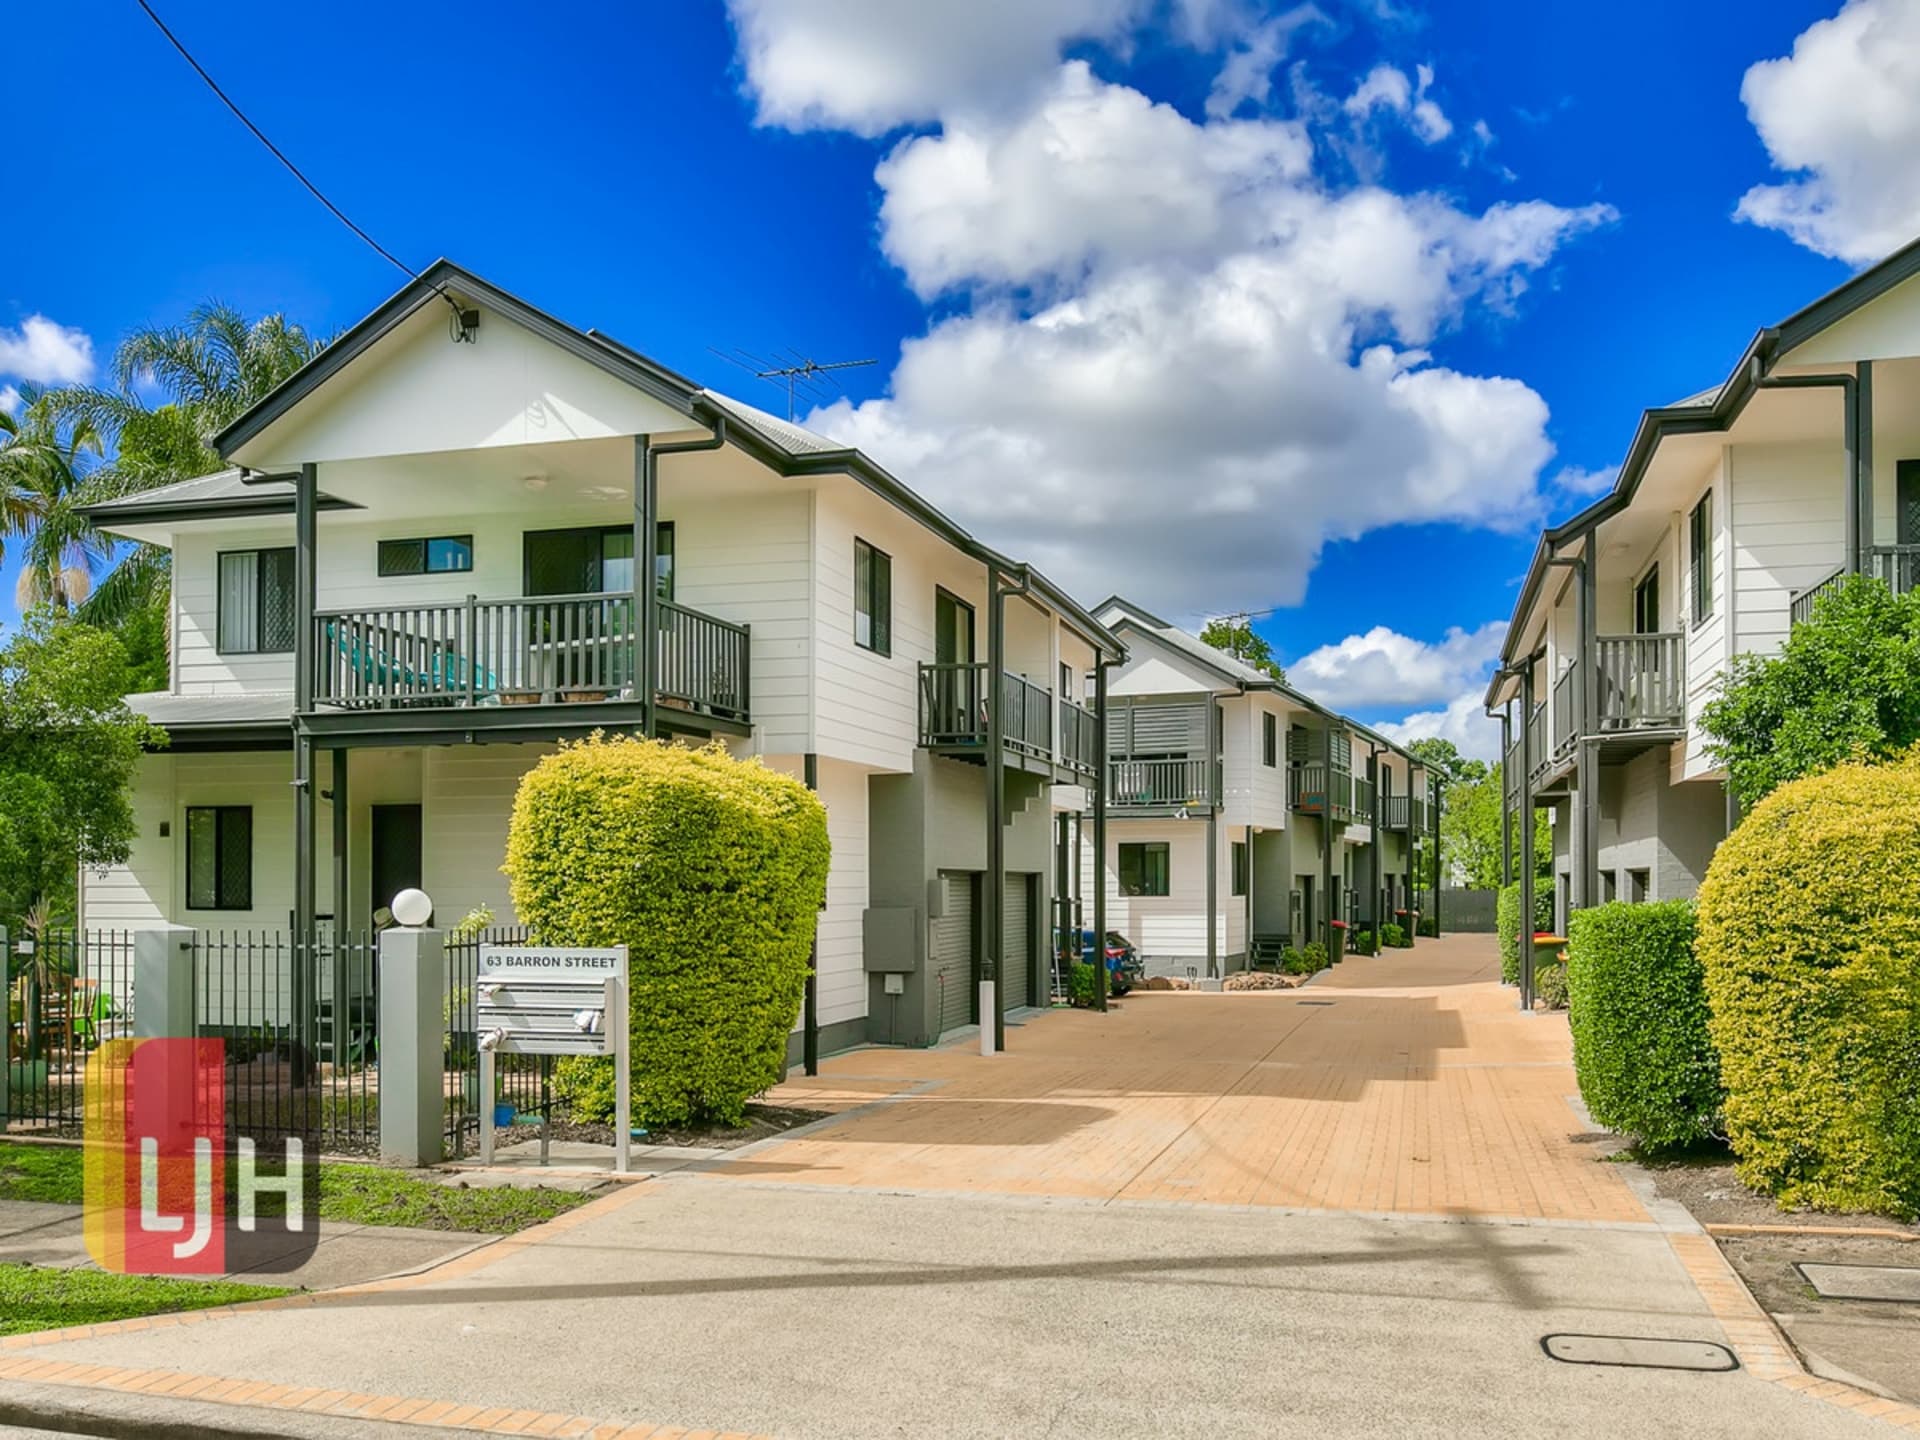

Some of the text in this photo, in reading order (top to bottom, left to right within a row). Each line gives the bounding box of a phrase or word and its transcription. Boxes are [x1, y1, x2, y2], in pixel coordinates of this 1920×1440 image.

[487, 956, 617, 969] 63 BARRON STREET
